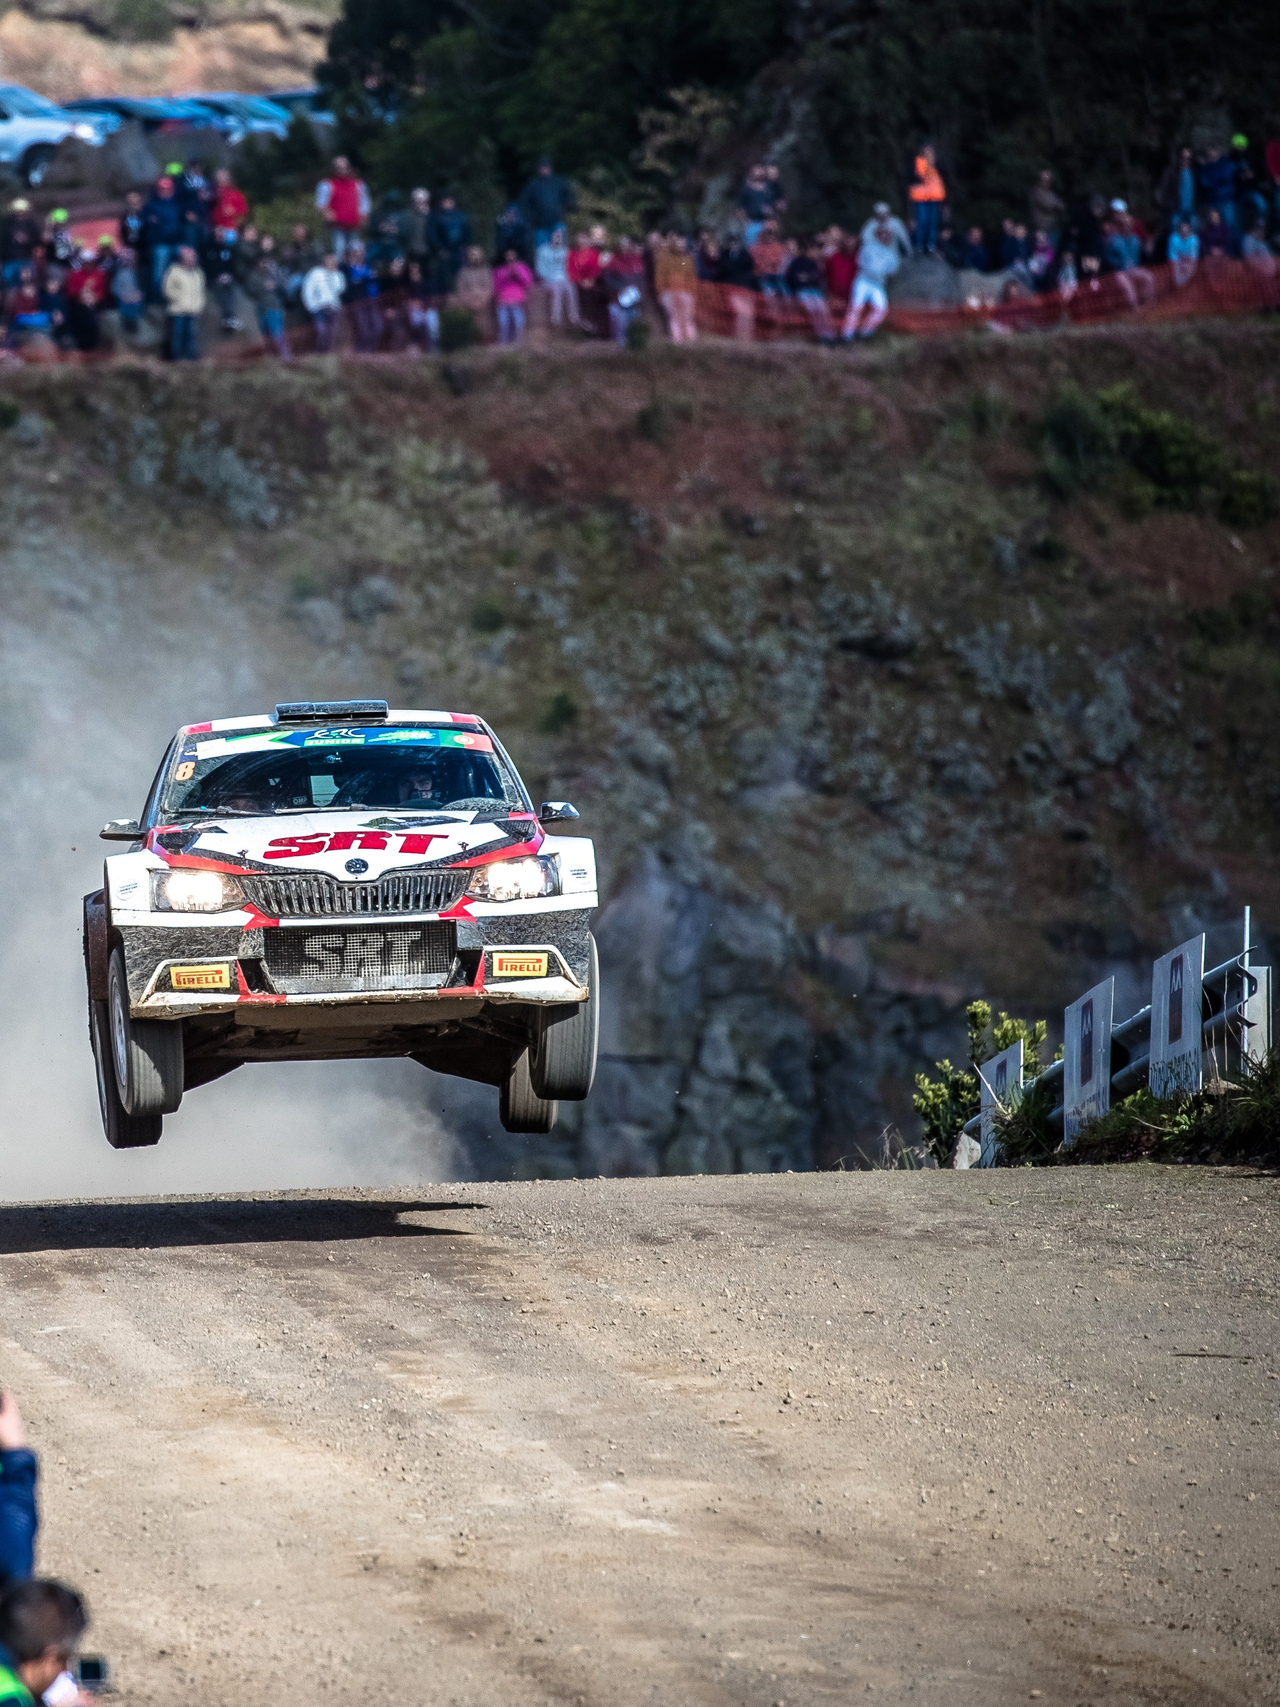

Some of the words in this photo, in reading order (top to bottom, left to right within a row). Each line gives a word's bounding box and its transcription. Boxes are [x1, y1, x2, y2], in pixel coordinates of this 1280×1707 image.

[307, 737, 362, 745] JUNIOR
[175, 761, 196, 782] 8
[263, 831, 450, 859] SRT
[299, 930, 422, 978] SRT
[498, 958, 543, 971] PIRELLI
[175, 970, 223, 985] PIRELLI
